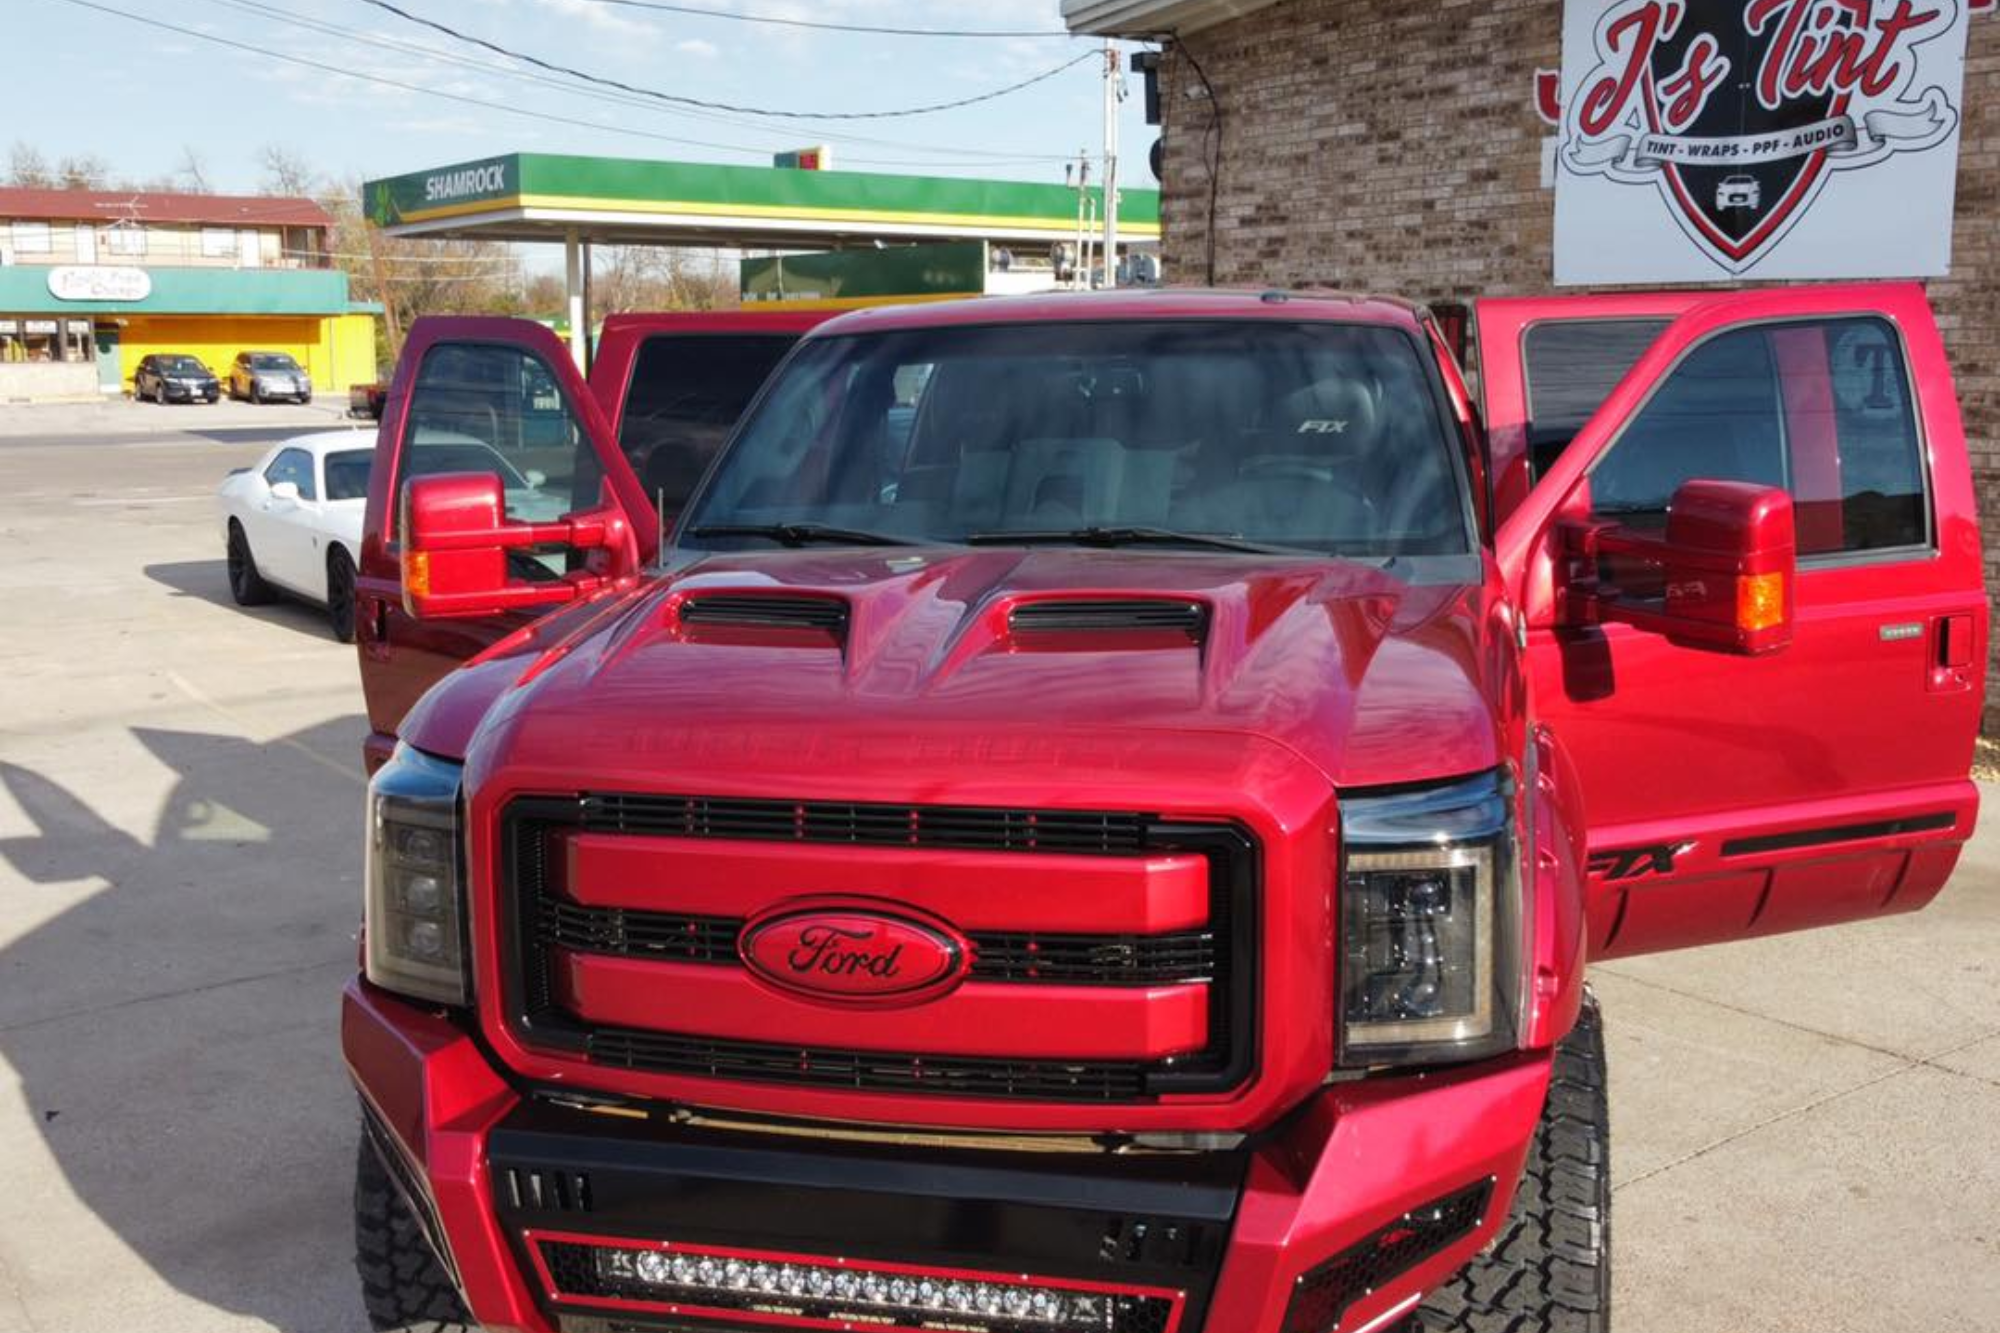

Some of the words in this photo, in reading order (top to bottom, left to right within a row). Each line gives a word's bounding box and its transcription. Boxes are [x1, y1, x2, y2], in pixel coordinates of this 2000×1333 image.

[1579, 0, 1722, 136] J's
[1744, 0, 1940, 104] Tint
[1648, 141, 1677, 157] TINT
[1688, 145, 1739, 158] WRAPS
[1752, 141, 1780, 156] PPF
[1793, 124, 1845, 149] AUDIO
[426, 164, 504, 200] SHAMROCK
[1297, 419, 1349, 433] FTX
[788, 925, 904, 977] Ford
